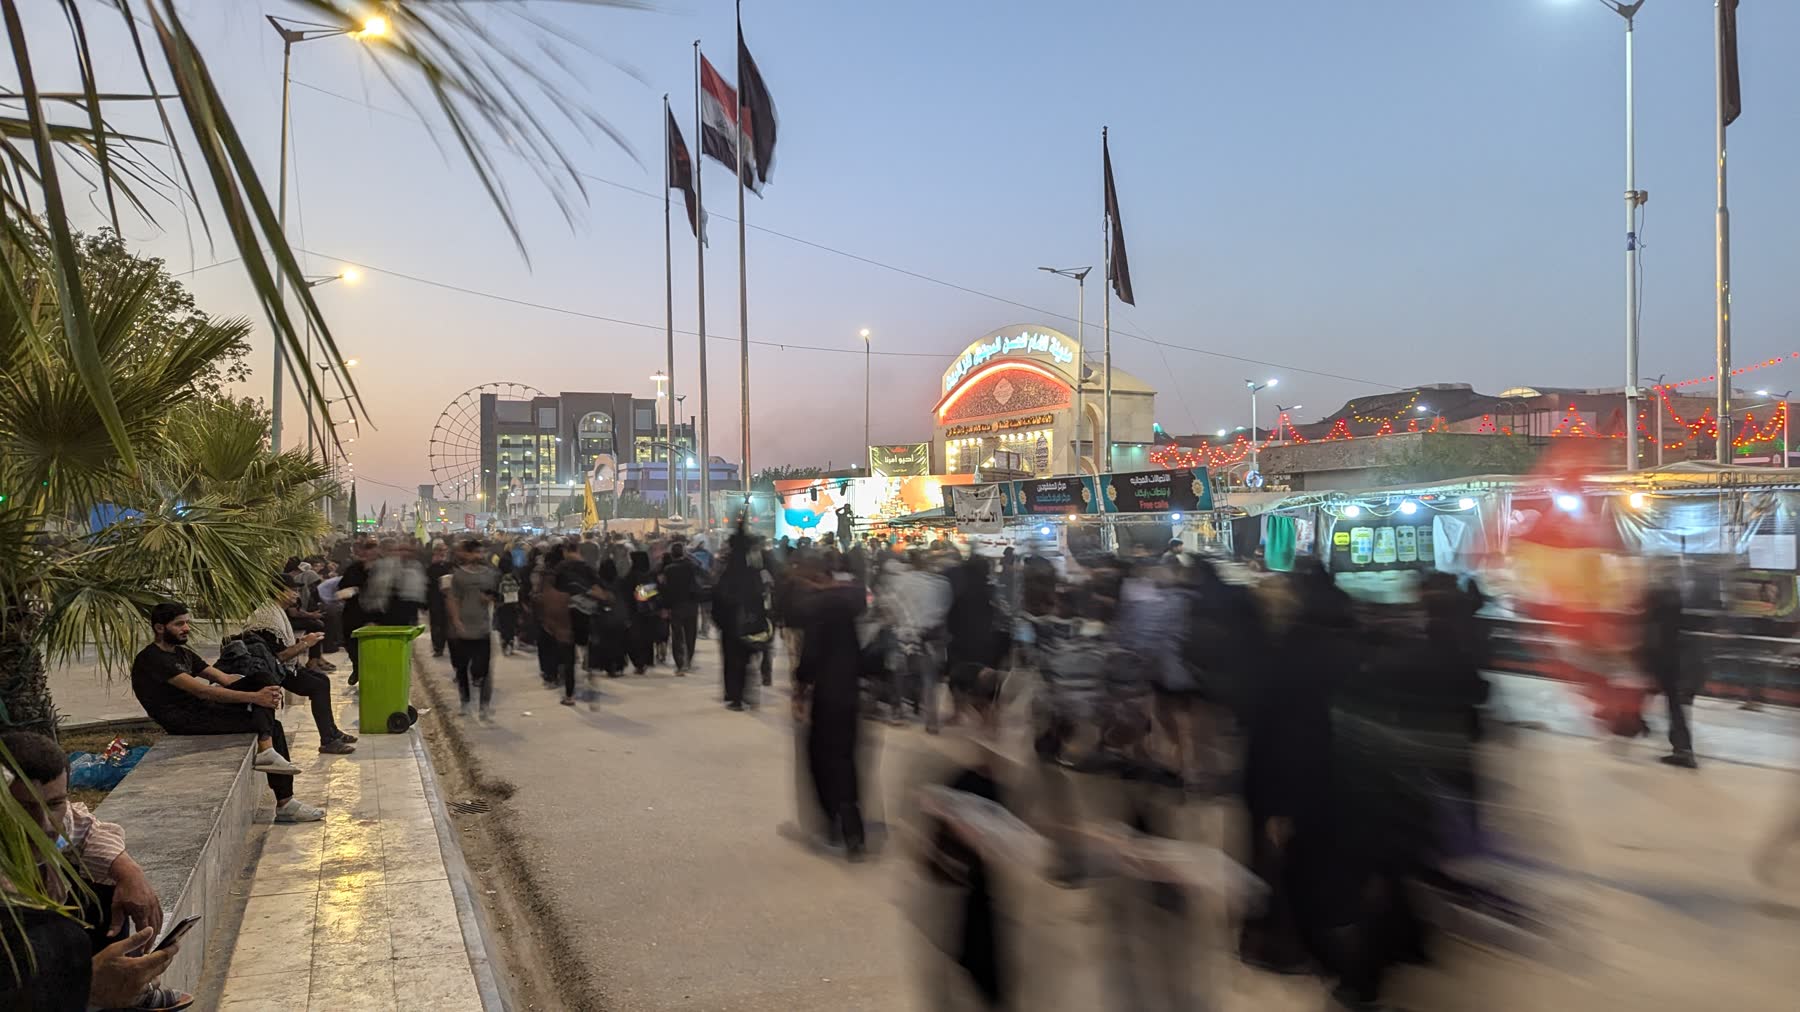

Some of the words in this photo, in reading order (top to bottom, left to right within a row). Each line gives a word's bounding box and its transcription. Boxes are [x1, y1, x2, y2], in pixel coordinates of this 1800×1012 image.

[1002, 331, 1028, 354] الحسن
[1036, 481, 1057, 493] المفقودين
[1139, 500, 1154, 510] Free
